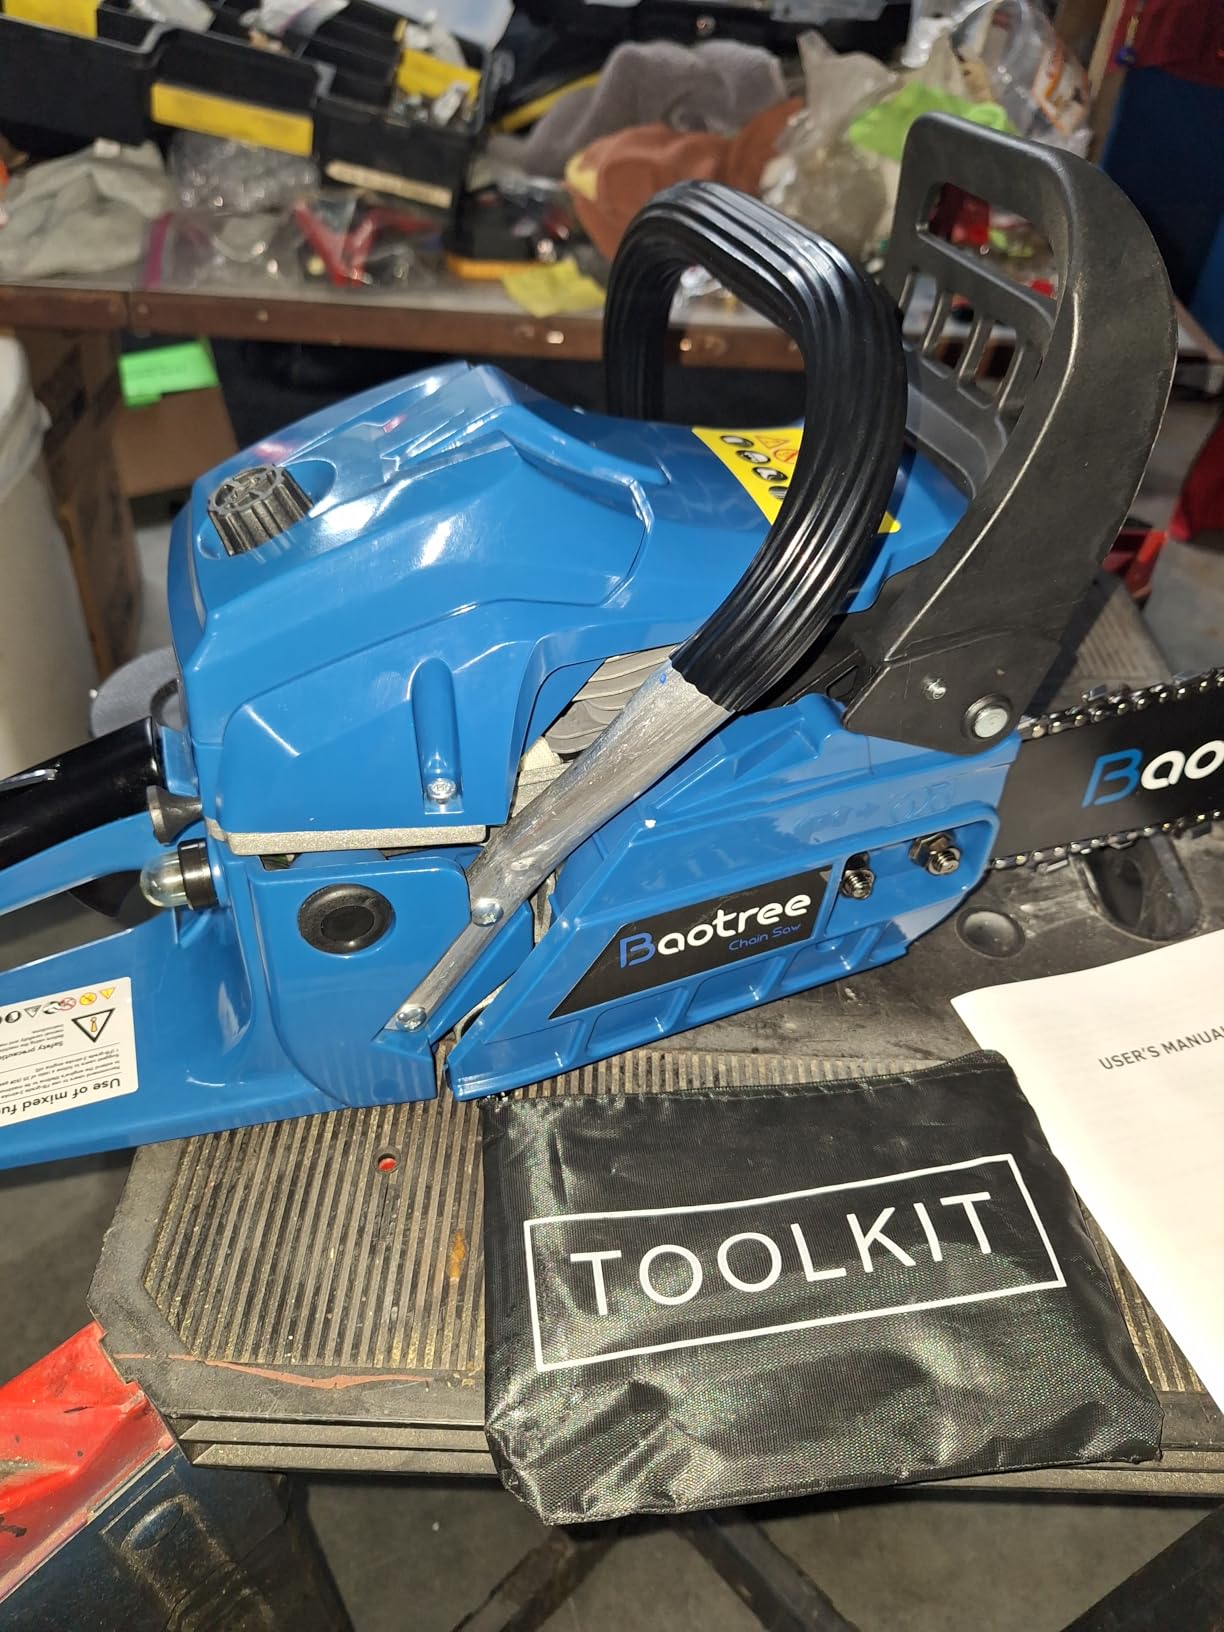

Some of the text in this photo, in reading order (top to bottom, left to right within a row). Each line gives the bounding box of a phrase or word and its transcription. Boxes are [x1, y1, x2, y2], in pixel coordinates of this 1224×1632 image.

[619, 894, 812, 968] Baotree
[728, 923, 801, 951] Chain Saw
[38, 1041, 63, 1050] Safety
[1098, 1046, 1160, 1070] USER'S
[0, 1078, 120, 1115] Use of mixed fu
[570, 1191, 992, 1316] TOOLKIT
